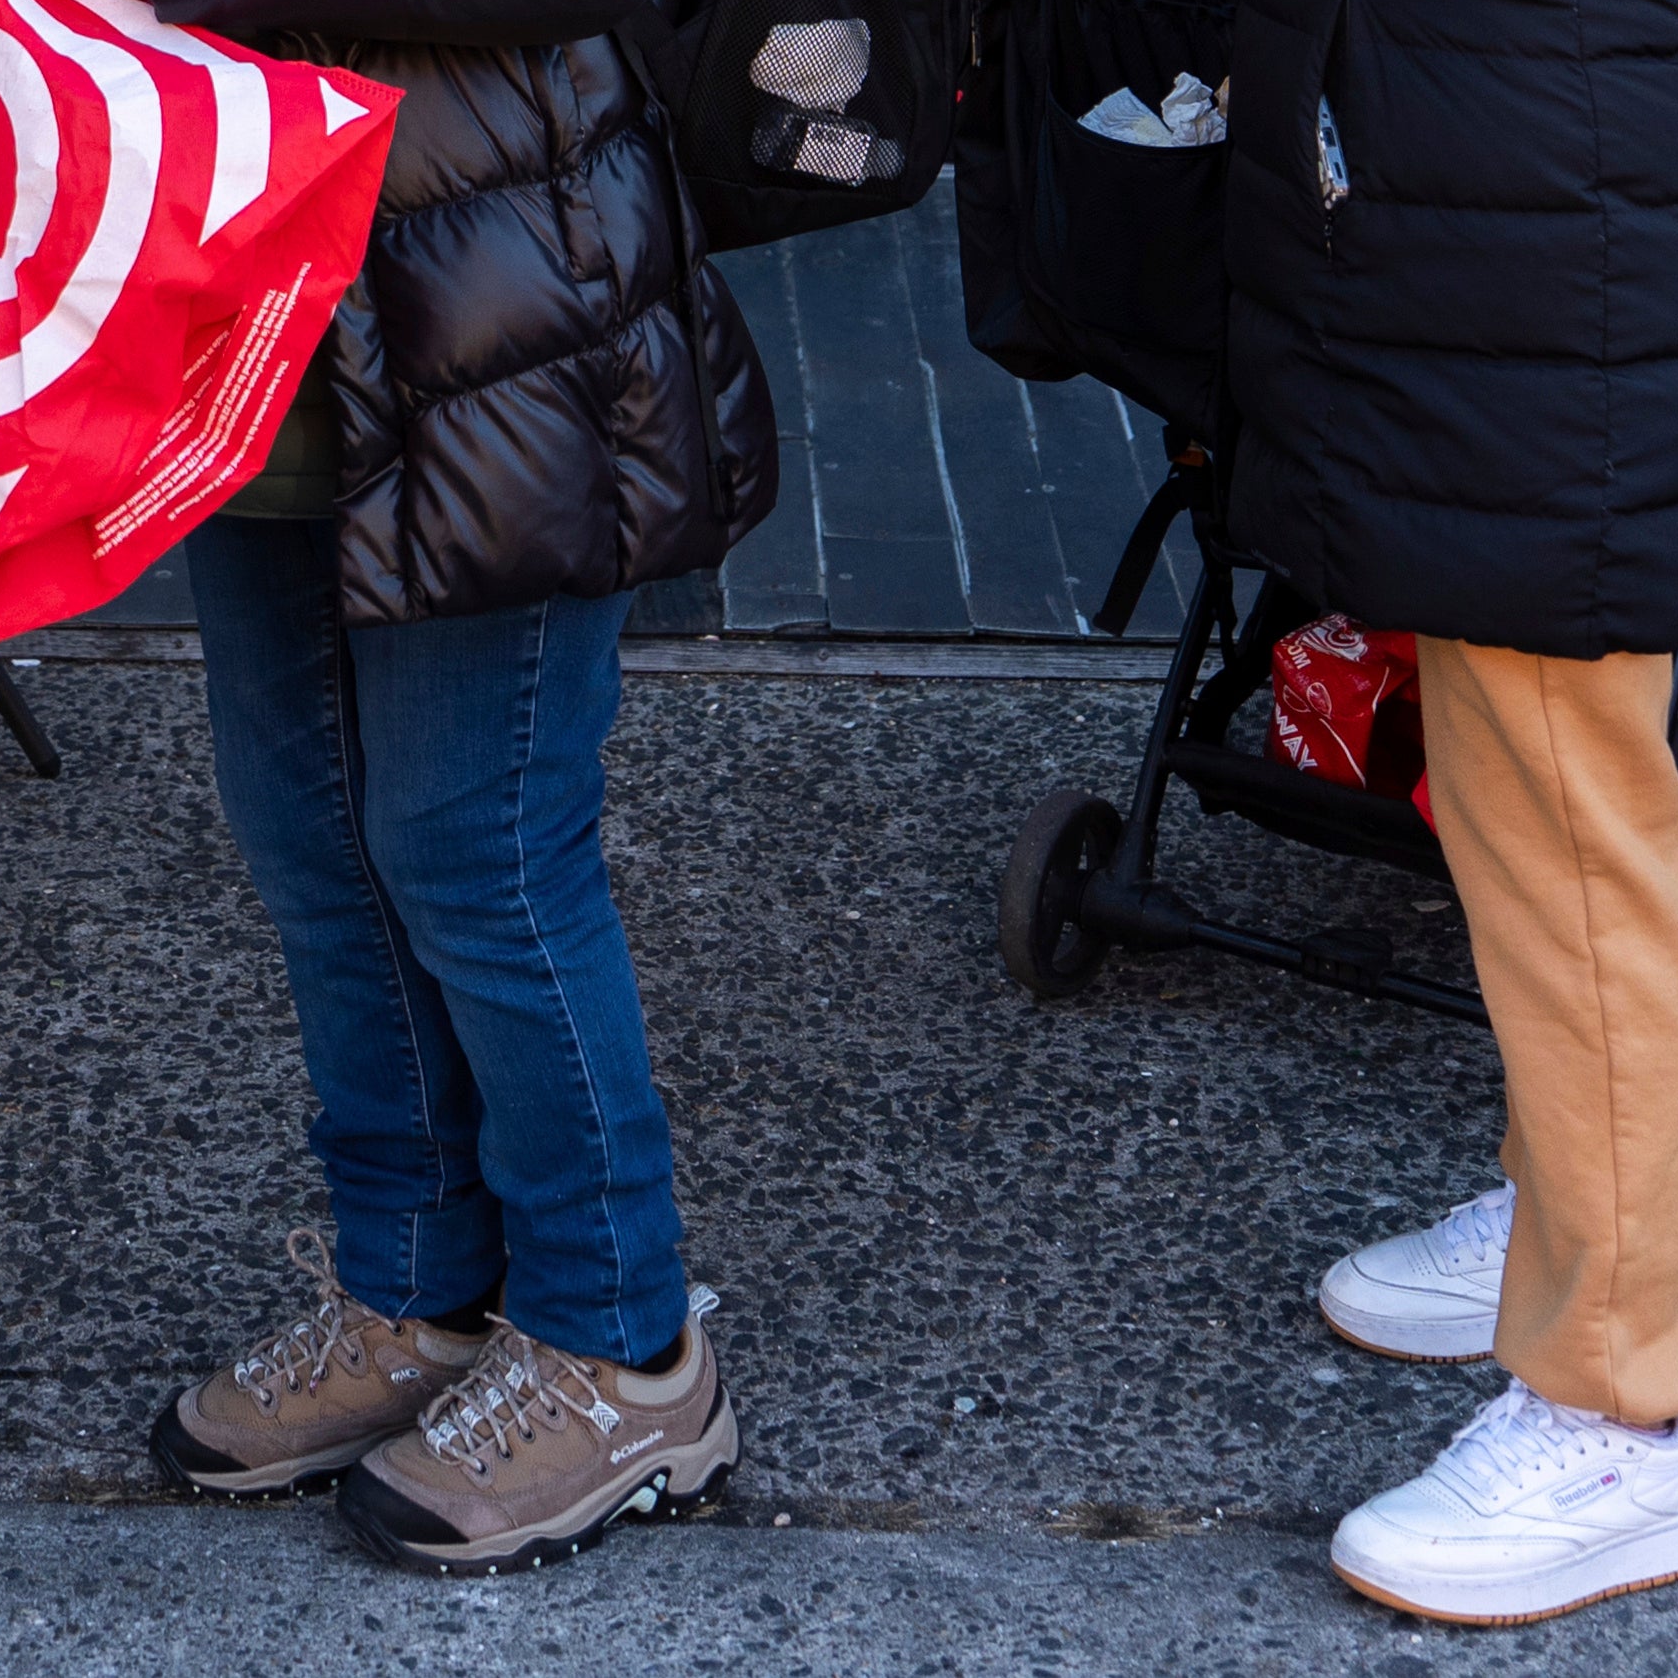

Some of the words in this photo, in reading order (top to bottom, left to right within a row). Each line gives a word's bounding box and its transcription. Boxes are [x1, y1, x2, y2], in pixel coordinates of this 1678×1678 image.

[298, 260, 311, 278] This
[262, 287, 276, 308] This
[273, 290, 286, 311] This
[283, 276, 304, 314] reusable
[252, 306, 267, 326] bag
[263, 309, 277, 329] bag
[274, 312, 288, 331] bag
[210, 329, 230, 349] Made
[244, 325, 259, 347] does
[237, 345, 249, 361] not
[240, 335, 264, 375] designed
[259, 337, 276, 364] made
[179, 354, 209, 382] Vietnam
[223, 359, 242, 388] contain
[274, 358, 288, 378] This
[226, 382, 240, 405] carry
[266, 377, 279, 395] bag
[253, 402, 268, 426] made
[174, 445, 194, 462] other
[183, 455, 199, 469] 175
[201, 451, 217, 466] with
[150, 460, 179, 484] metals
[169, 466, 188, 483] feet
[218, 465, 234, 480] Use
[158, 480, 174, 492] for
[164, 469, 199, 501] minimum
[196, 484, 215, 497] and
[124, 489, 147, 507] toxic
[131, 497, 153, 516] least
[93, 504, 128, 531] amounts
[118, 514, 134, 526] 125
[135, 498, 169, 525] material
[110, 522, 139, 546] weight
[620, 1428, 664, 1460] Columbia
[1554, 1480, 1602, 1508] Reebok
